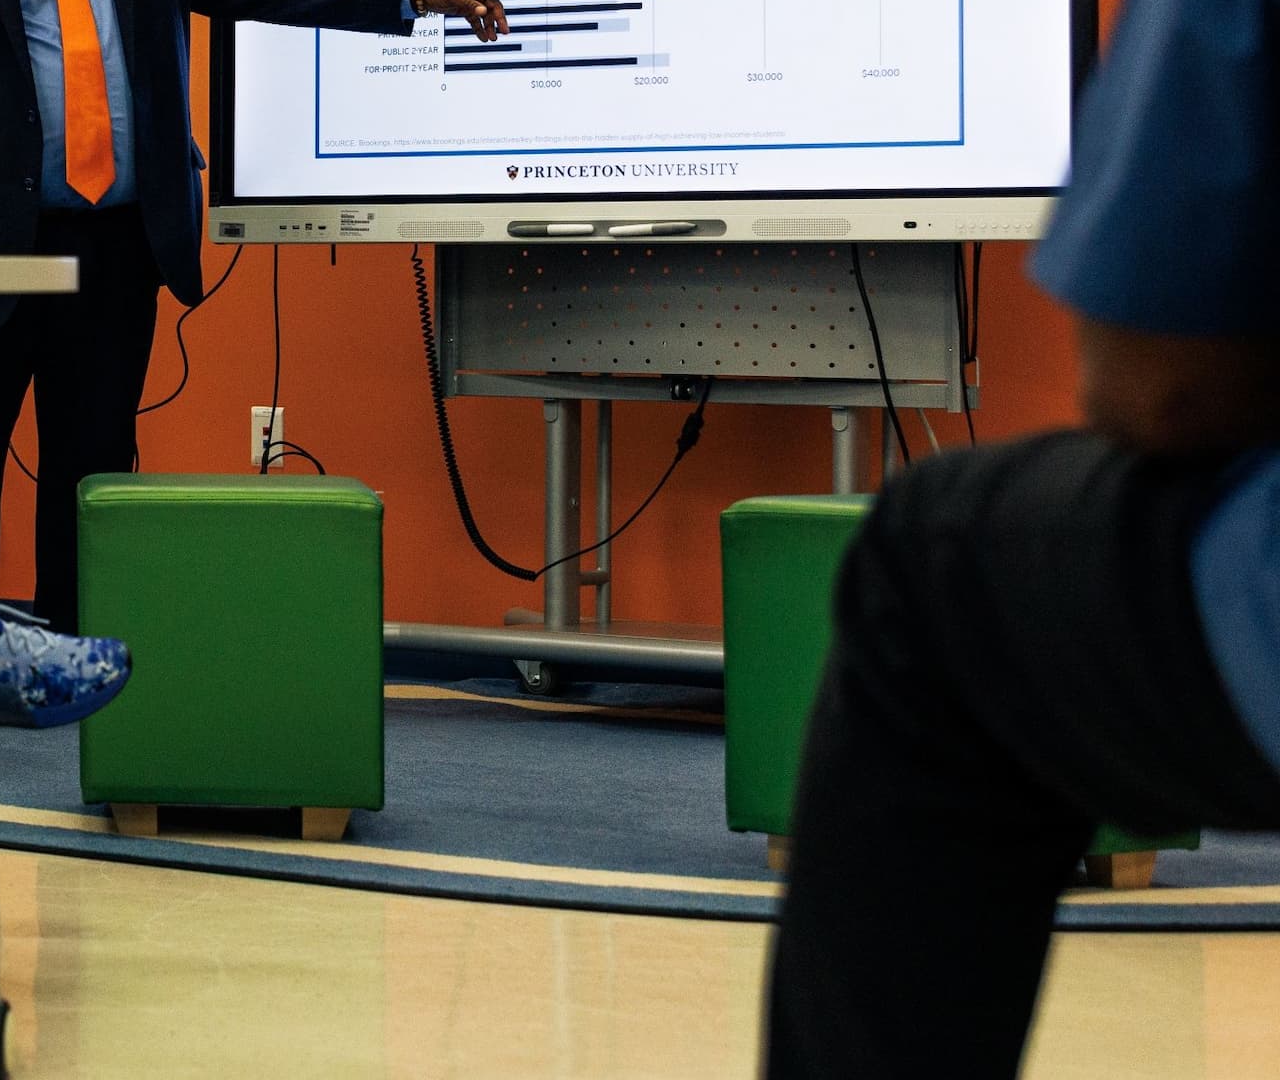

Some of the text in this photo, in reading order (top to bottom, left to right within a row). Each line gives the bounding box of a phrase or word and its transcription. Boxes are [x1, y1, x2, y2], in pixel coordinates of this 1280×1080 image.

[412, 28, 439, 37] 2-YEAR
[382, 46, 439, 56] PUBLIC 2-YEAR
[364, 63, 439, 73] FOR-PROFIT 2-YEAR
[862, 68, 900, 78] $40,000
[634, 76, 669, 86] $20,000
[747, 72, 783, 82] $30,000
[441, 83, 447, 91] 0
[530, 79, 562, 89] $10,000
[523, 162, 740, 178] PRINCETON UNIVERSITY
